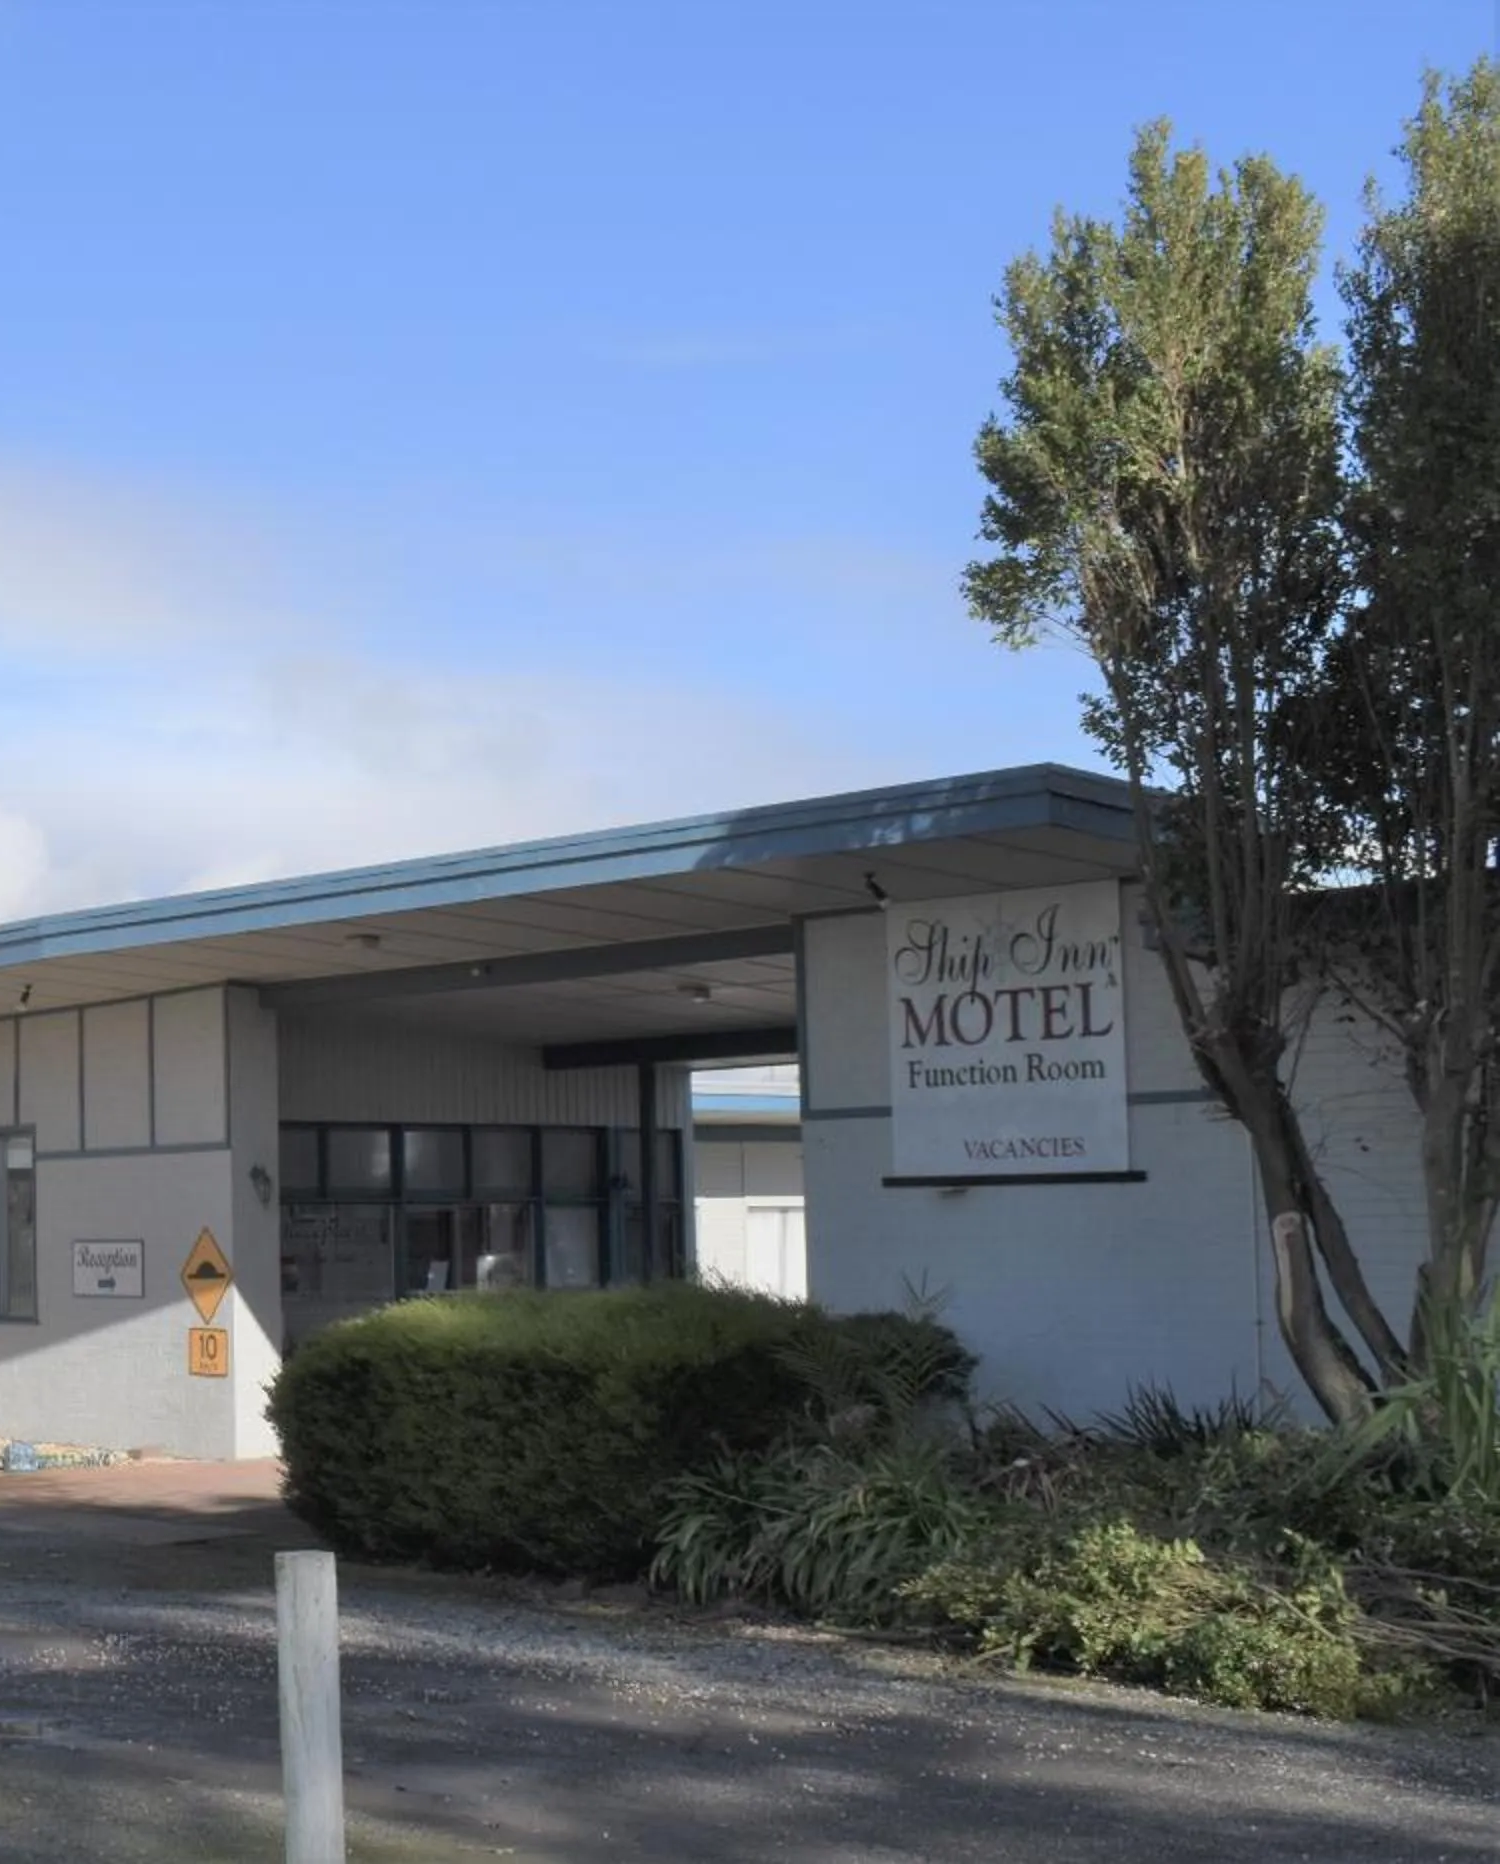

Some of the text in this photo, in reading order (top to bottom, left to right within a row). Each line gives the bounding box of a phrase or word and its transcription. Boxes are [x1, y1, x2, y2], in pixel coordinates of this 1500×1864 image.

[895, 904, 1113, 1004] Ship Inn
[900, 982, 1113, 1049] MOTEL
[907, 1053, 1105, 1089] Function Room
[963, 1137, 1087, 1161] VACANCIES
[76, 1245, 138, 1274] Reception
[199, 1334, 218, 1361] 10
